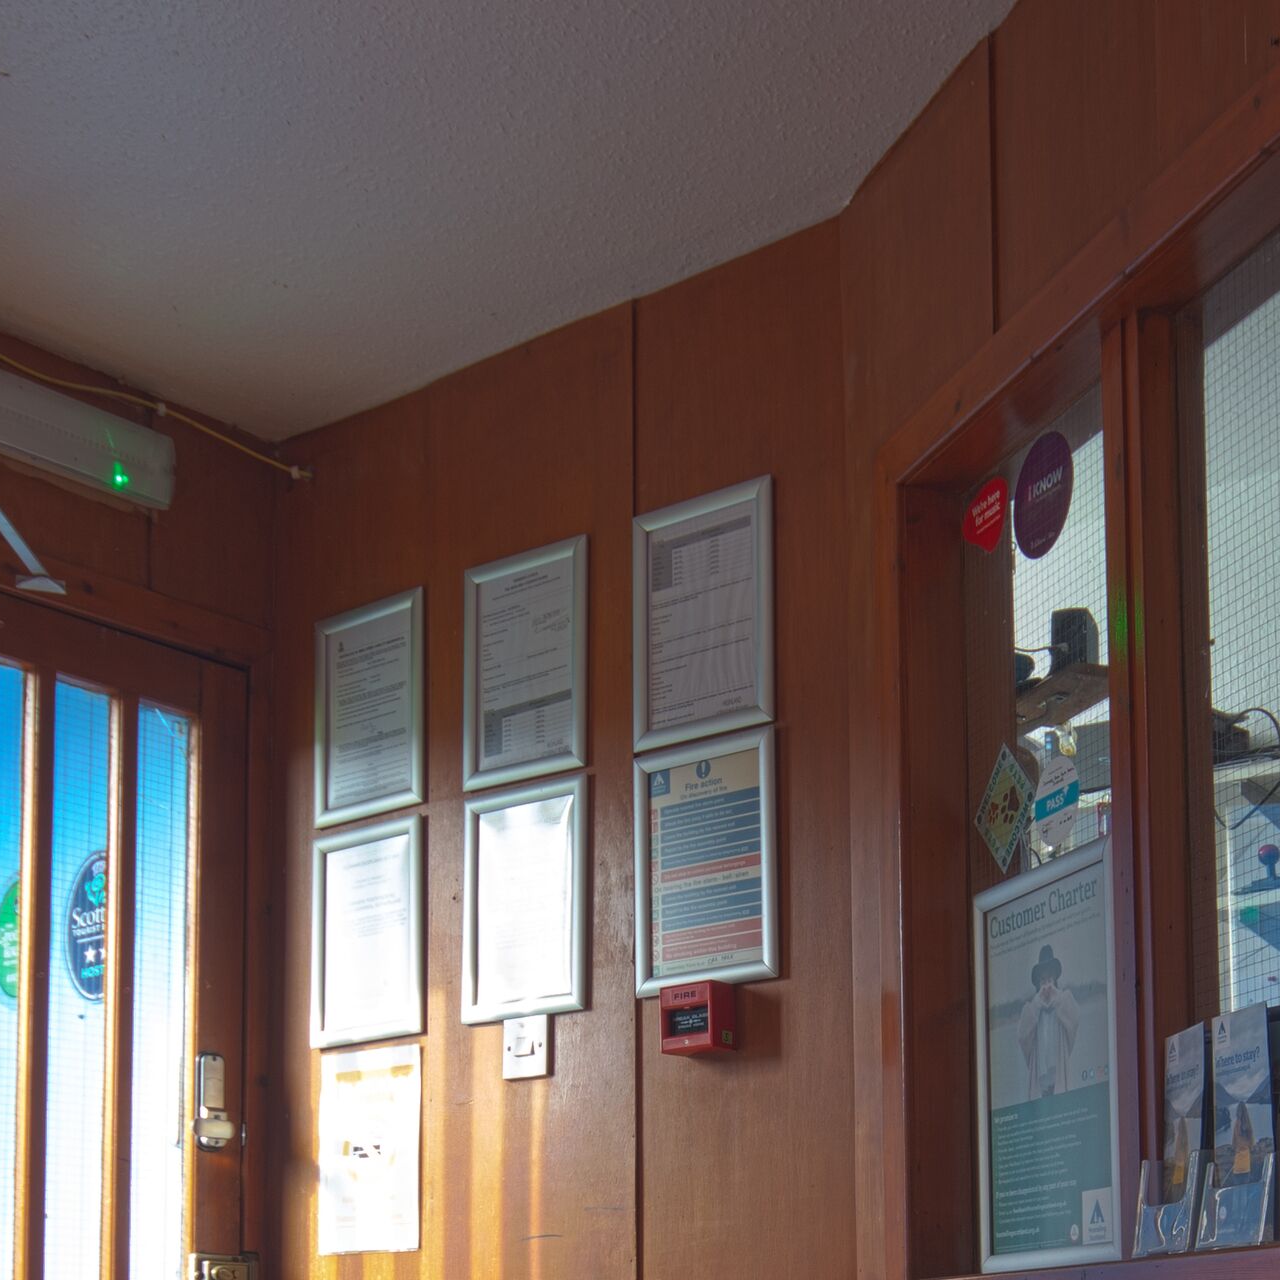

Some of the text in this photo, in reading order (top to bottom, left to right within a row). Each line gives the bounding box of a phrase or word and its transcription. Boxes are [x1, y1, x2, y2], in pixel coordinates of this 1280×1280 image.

[1027, 465, 1064, 502] I KNOW
[685, 777, 723, 792] Fire action
[981, 760, 1003, 815] WELCOME
[1045, 792, 1066, 812] PASS
[1006, 804, 1029, 856] WELCOME
[990, 900, 1047, 939] Customer
[1048, 880, 1097, 914] Charter
[674, 990, 697, 1000] FIRE
[1243, 1046, 1260, 1062] stay?
